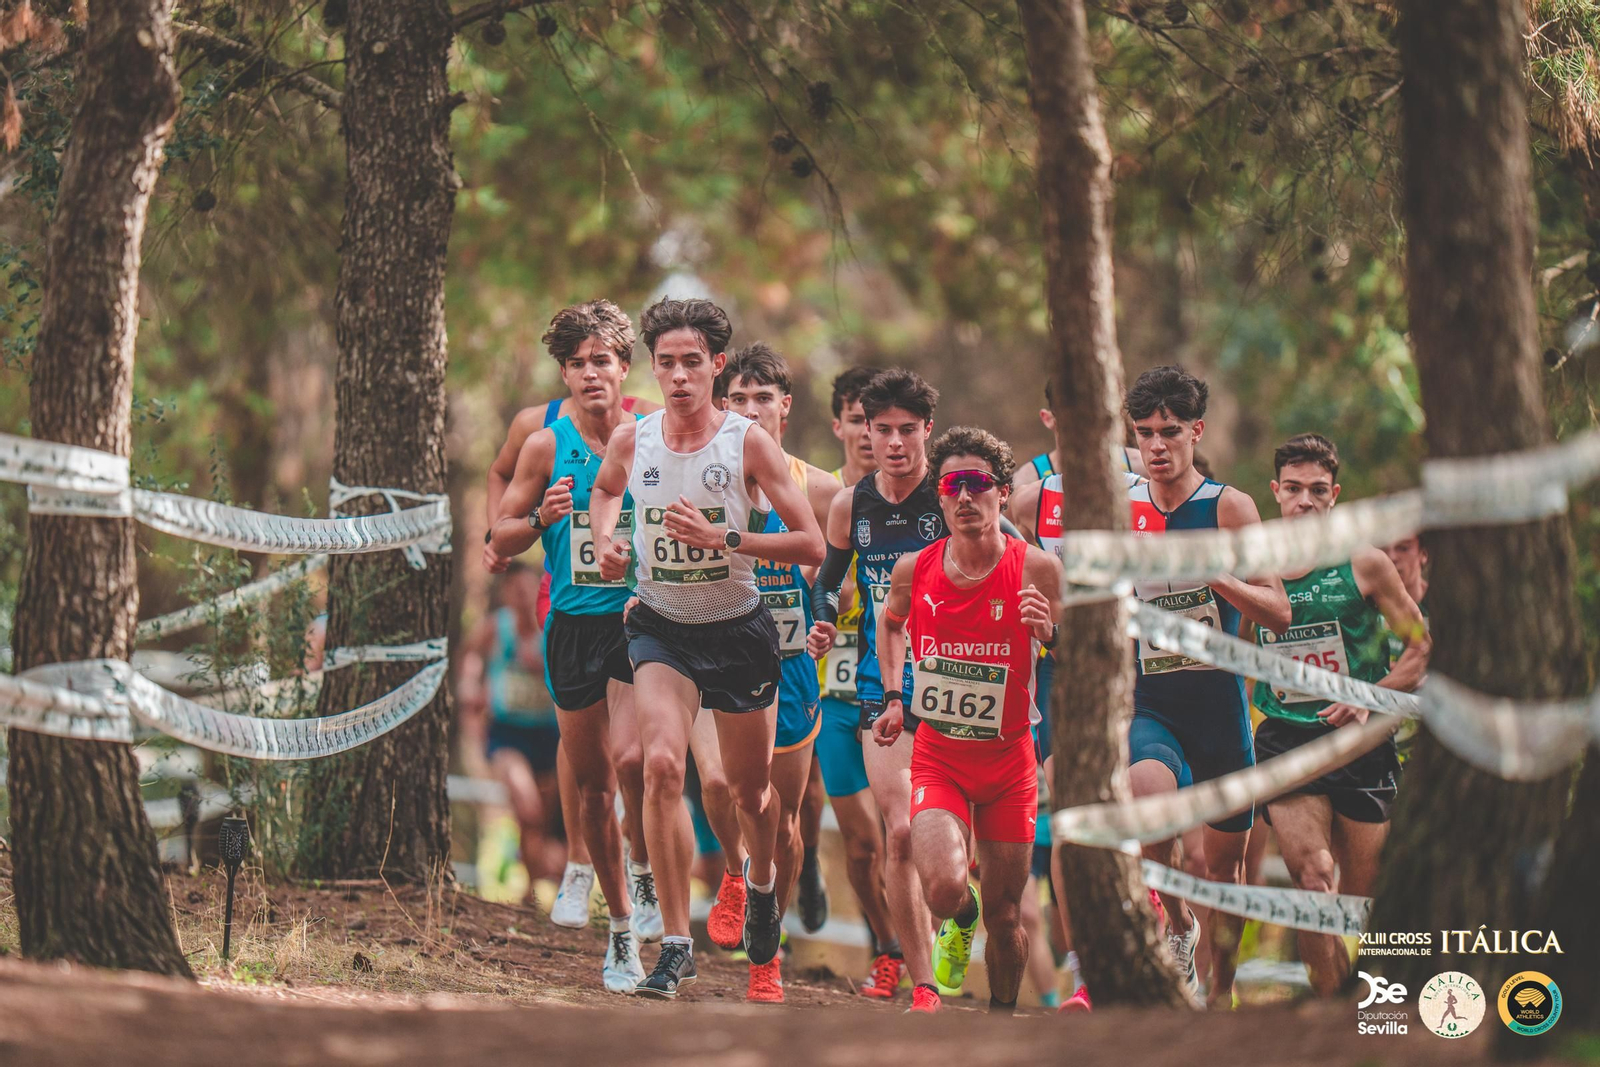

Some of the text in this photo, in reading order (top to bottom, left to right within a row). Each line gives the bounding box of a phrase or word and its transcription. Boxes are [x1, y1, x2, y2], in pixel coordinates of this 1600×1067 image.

[867, 554, 886, 562] CLUB
[756, 574, 793, 587] SIDAD
[941, 642, 1010, 656] navarra
[942, 660, 983, 676] ITÁLICA
[921, 686, 996, 721] 6162
